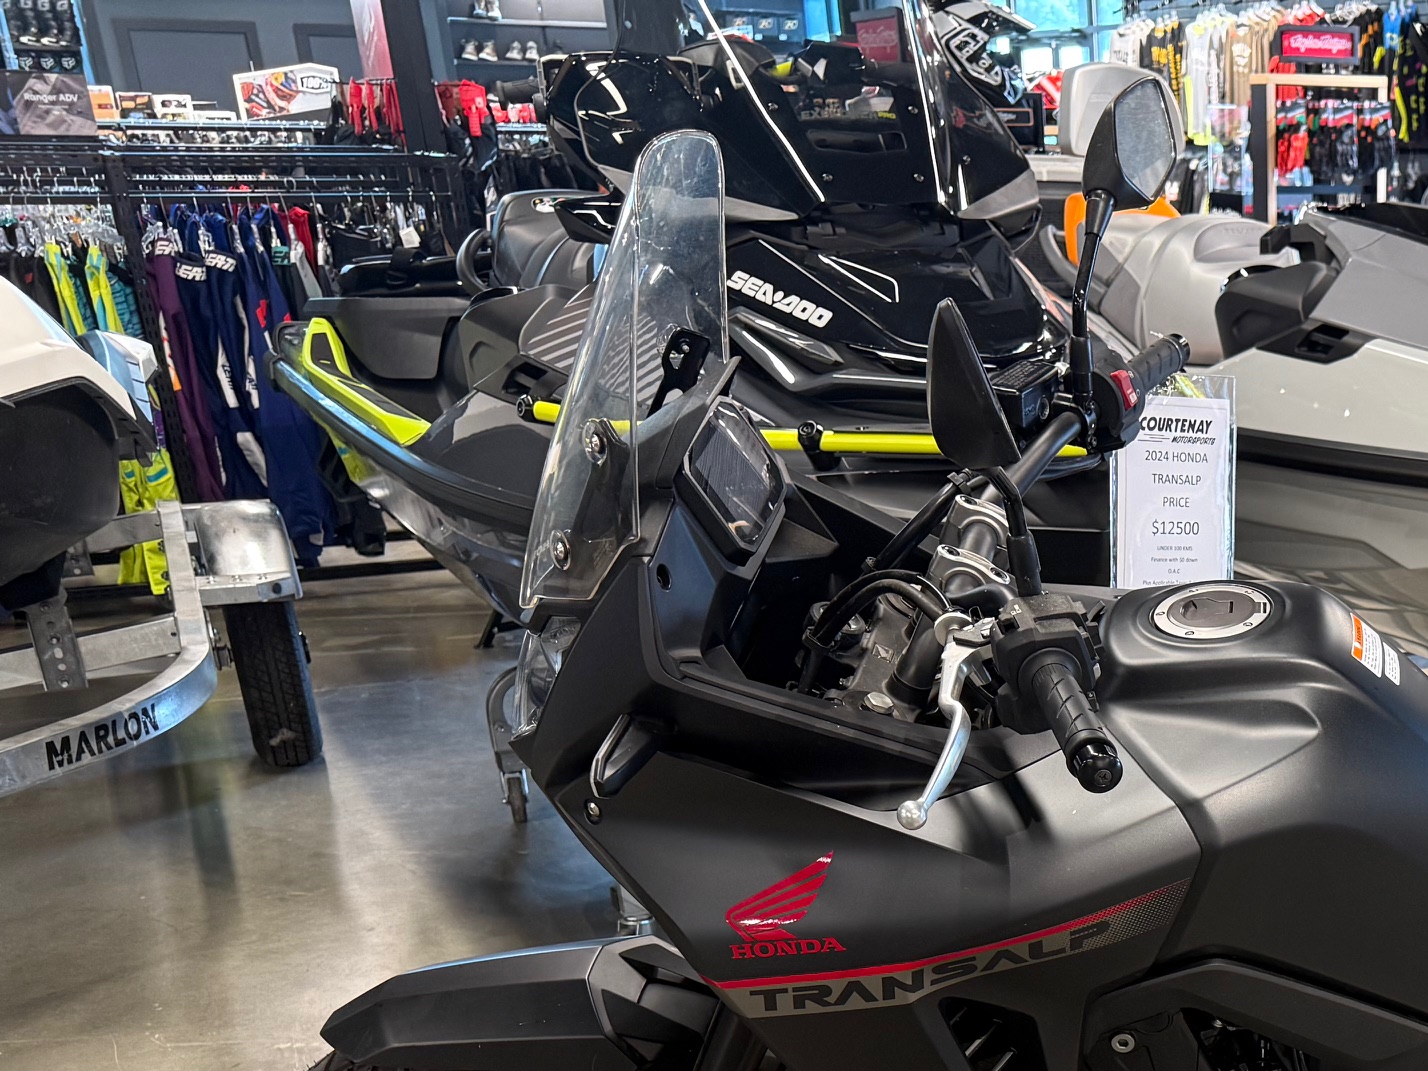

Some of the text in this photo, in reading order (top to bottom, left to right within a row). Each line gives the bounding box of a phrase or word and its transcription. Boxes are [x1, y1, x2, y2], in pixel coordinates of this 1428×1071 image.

[24, 93, 78, 104] Ranger ADV
[1140, 416, 1213, 434] COURTENAY
[1171, 436, 1216, 445] MOTORSPORTS
[1145, 450, 1208, 463] 2024 HONDA
[1152, 473, 1202, 485] TRANSALP
[1162, 496, 1190, 508] PRICE
[1152, 519, 1200, 536] $12500
[45, 703, 160, 771] MARLON
[729, 936, 847, 959] HONDA
[749, 920, 1110, 1012] TRANSALP
